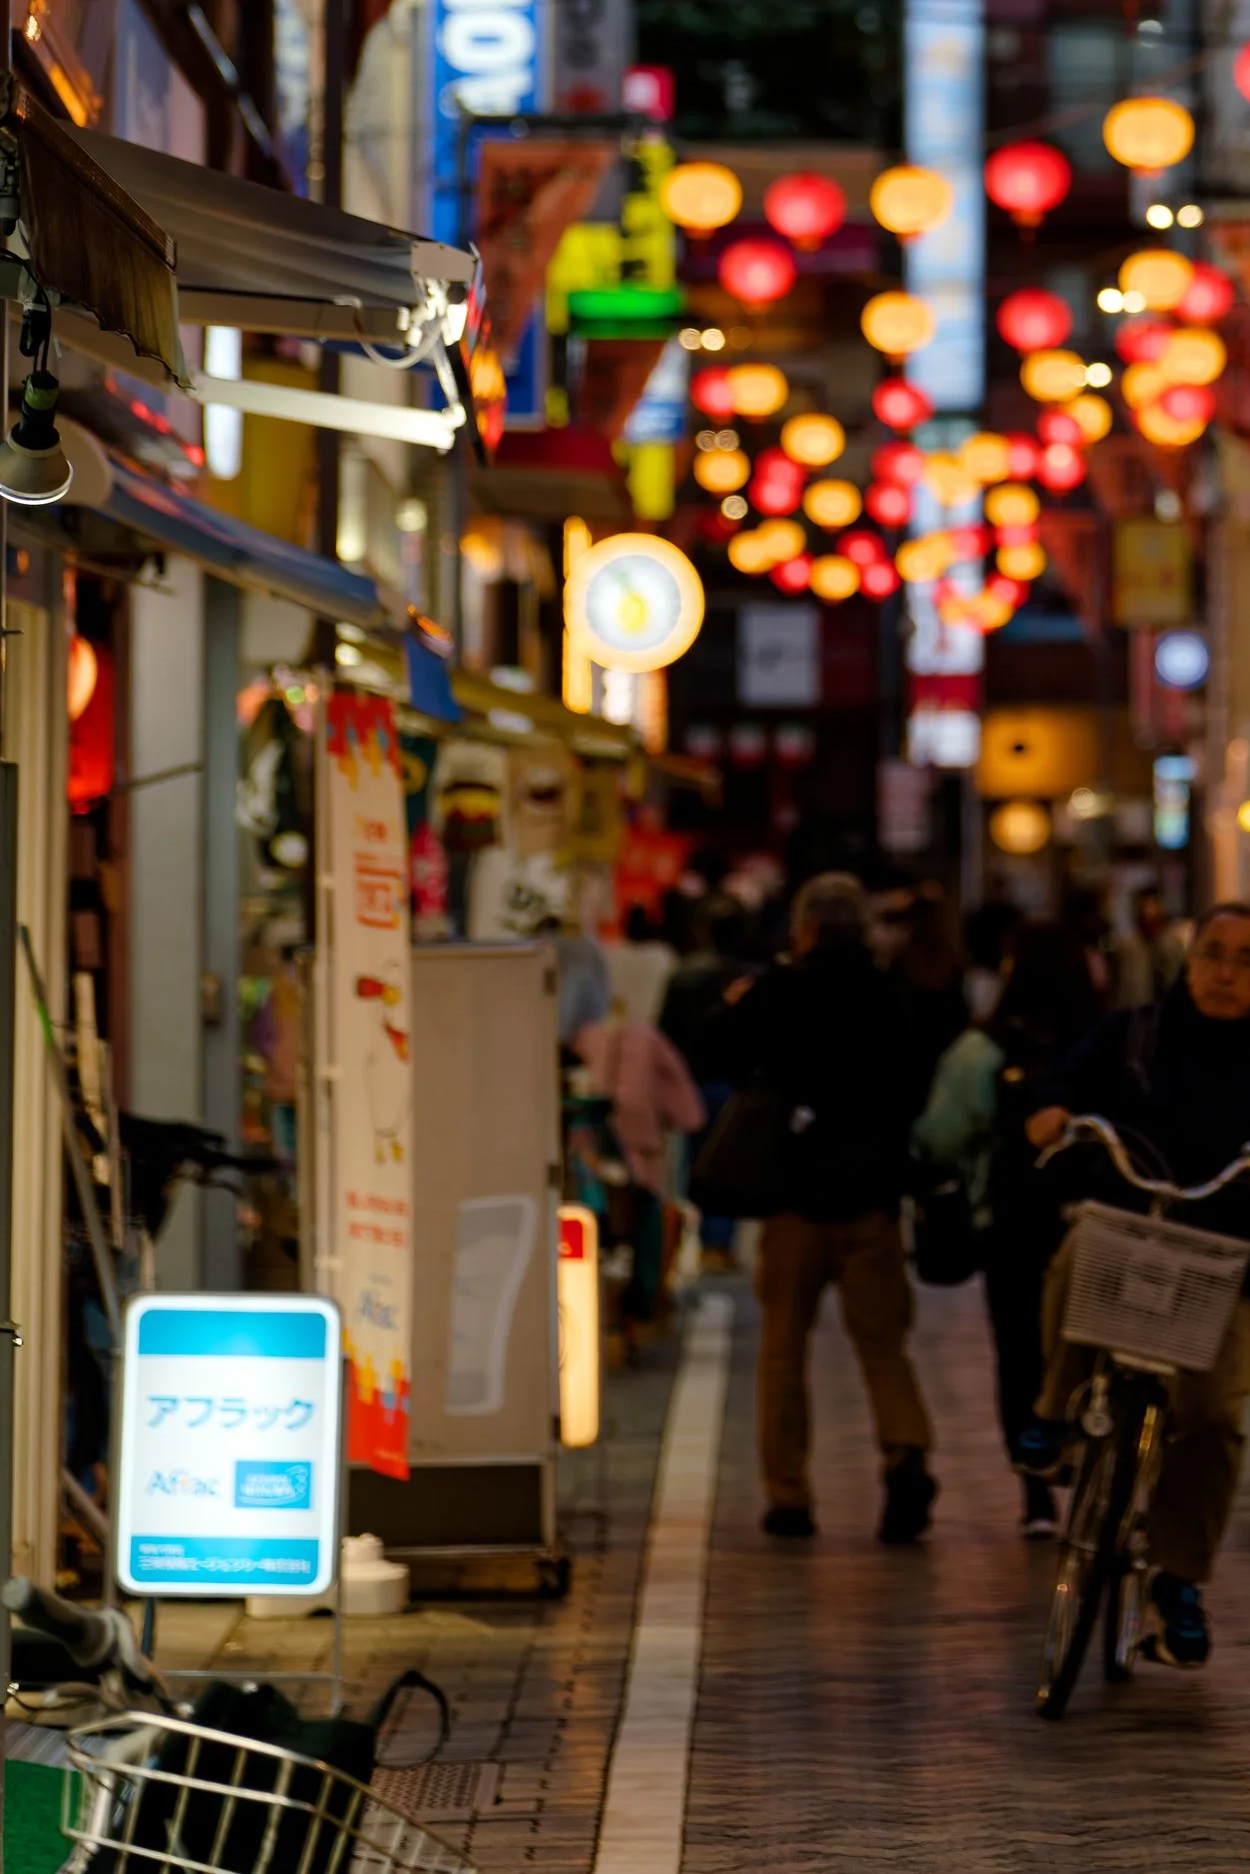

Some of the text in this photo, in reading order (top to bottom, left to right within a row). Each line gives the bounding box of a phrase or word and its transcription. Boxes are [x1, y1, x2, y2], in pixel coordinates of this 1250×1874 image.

[145, 1394, 316, 1430] アフラック
